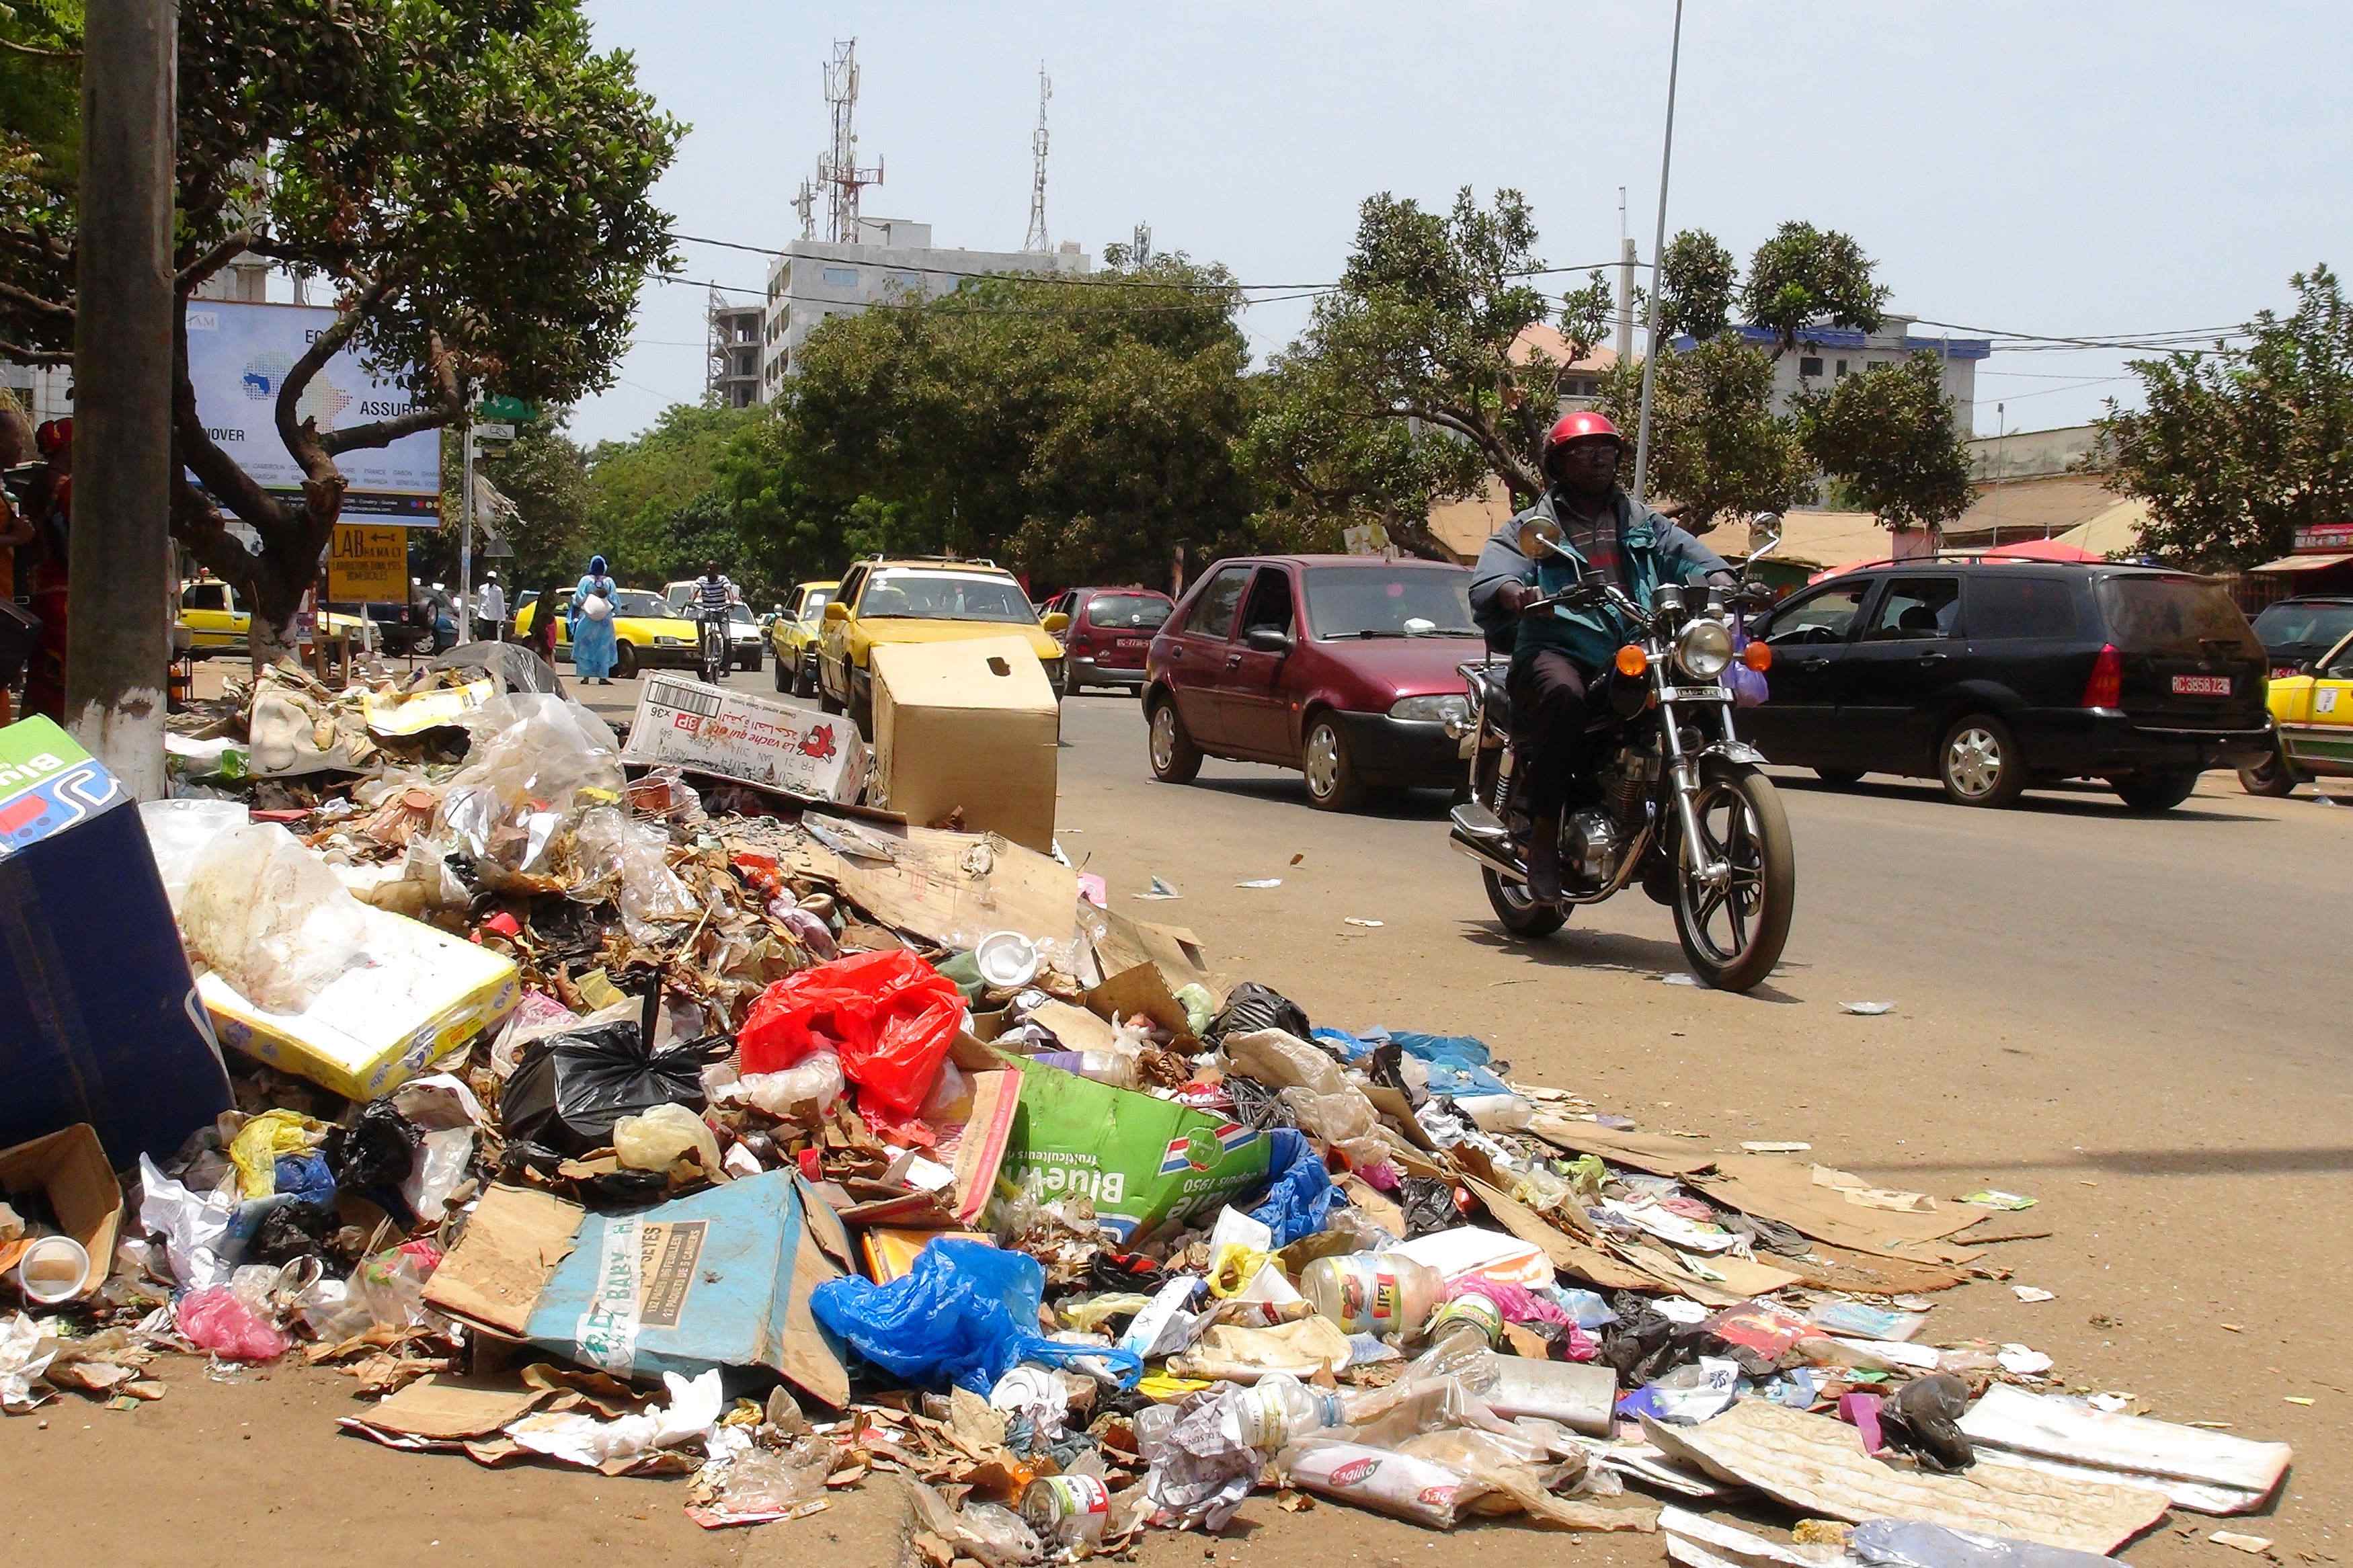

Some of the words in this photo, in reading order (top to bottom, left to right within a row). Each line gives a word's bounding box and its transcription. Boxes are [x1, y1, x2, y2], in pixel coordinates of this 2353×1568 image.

[332, 529, 364, 559] LAB
[650, 706, 671, 718] x36
[731, 728, 748, 740] qui
[748, 734, 780, 749] vache
[782, 742, 796, 753] La
[1183, 1179, 1213, 1194] 1950
[606, 1250, 632, 1300] BABY
[1331, 1464, 1375, 1485] Sagiko
[1423, 1488, 1451, 1507] Sag
